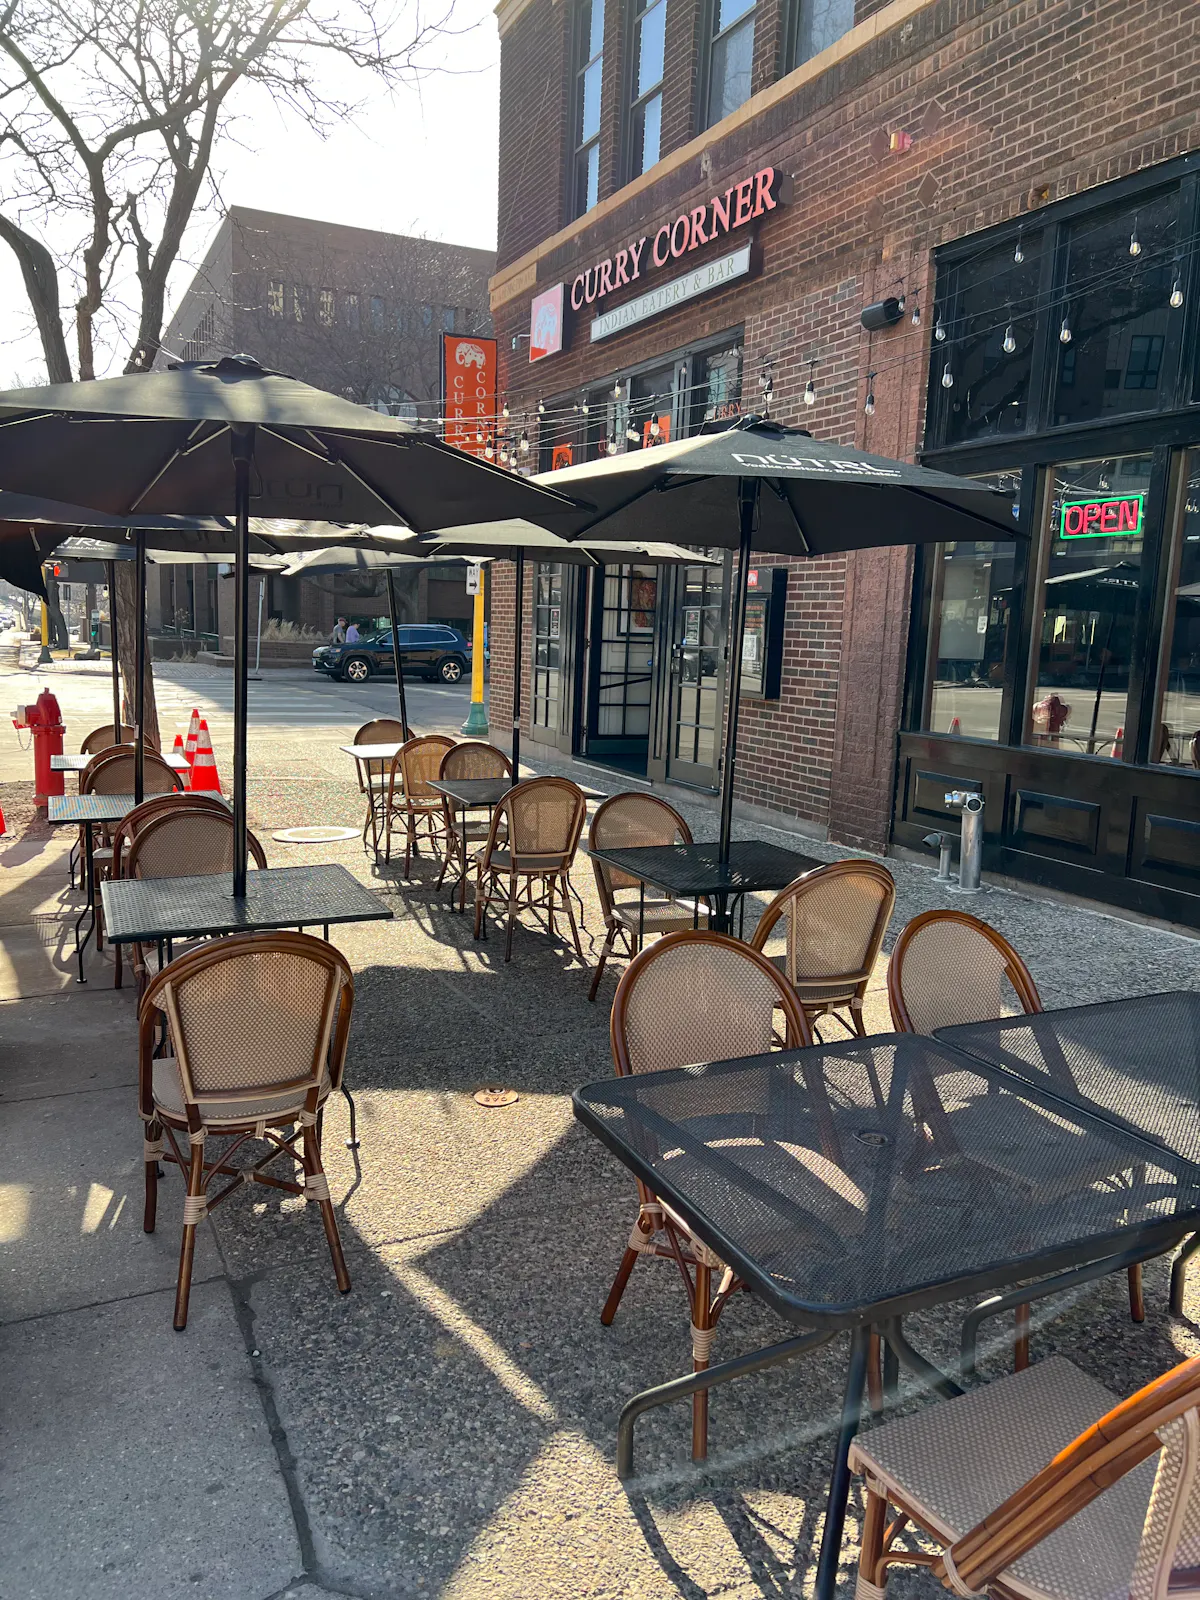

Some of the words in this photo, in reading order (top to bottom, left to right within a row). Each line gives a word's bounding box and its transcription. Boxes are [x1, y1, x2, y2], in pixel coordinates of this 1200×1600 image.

[571, 236, 646, 311] CURRY
[653, 166, 777, 268] CORNER
[600, 303, 639, 335] INDIAN
[641, 278, 689, 316] EATERY
[693, 273, 702, 292] &
[707, 256, 736, 286] BAR
[453, 375, 464, 450] CURRY
[1065, 500, 1138, 535] OPEN
